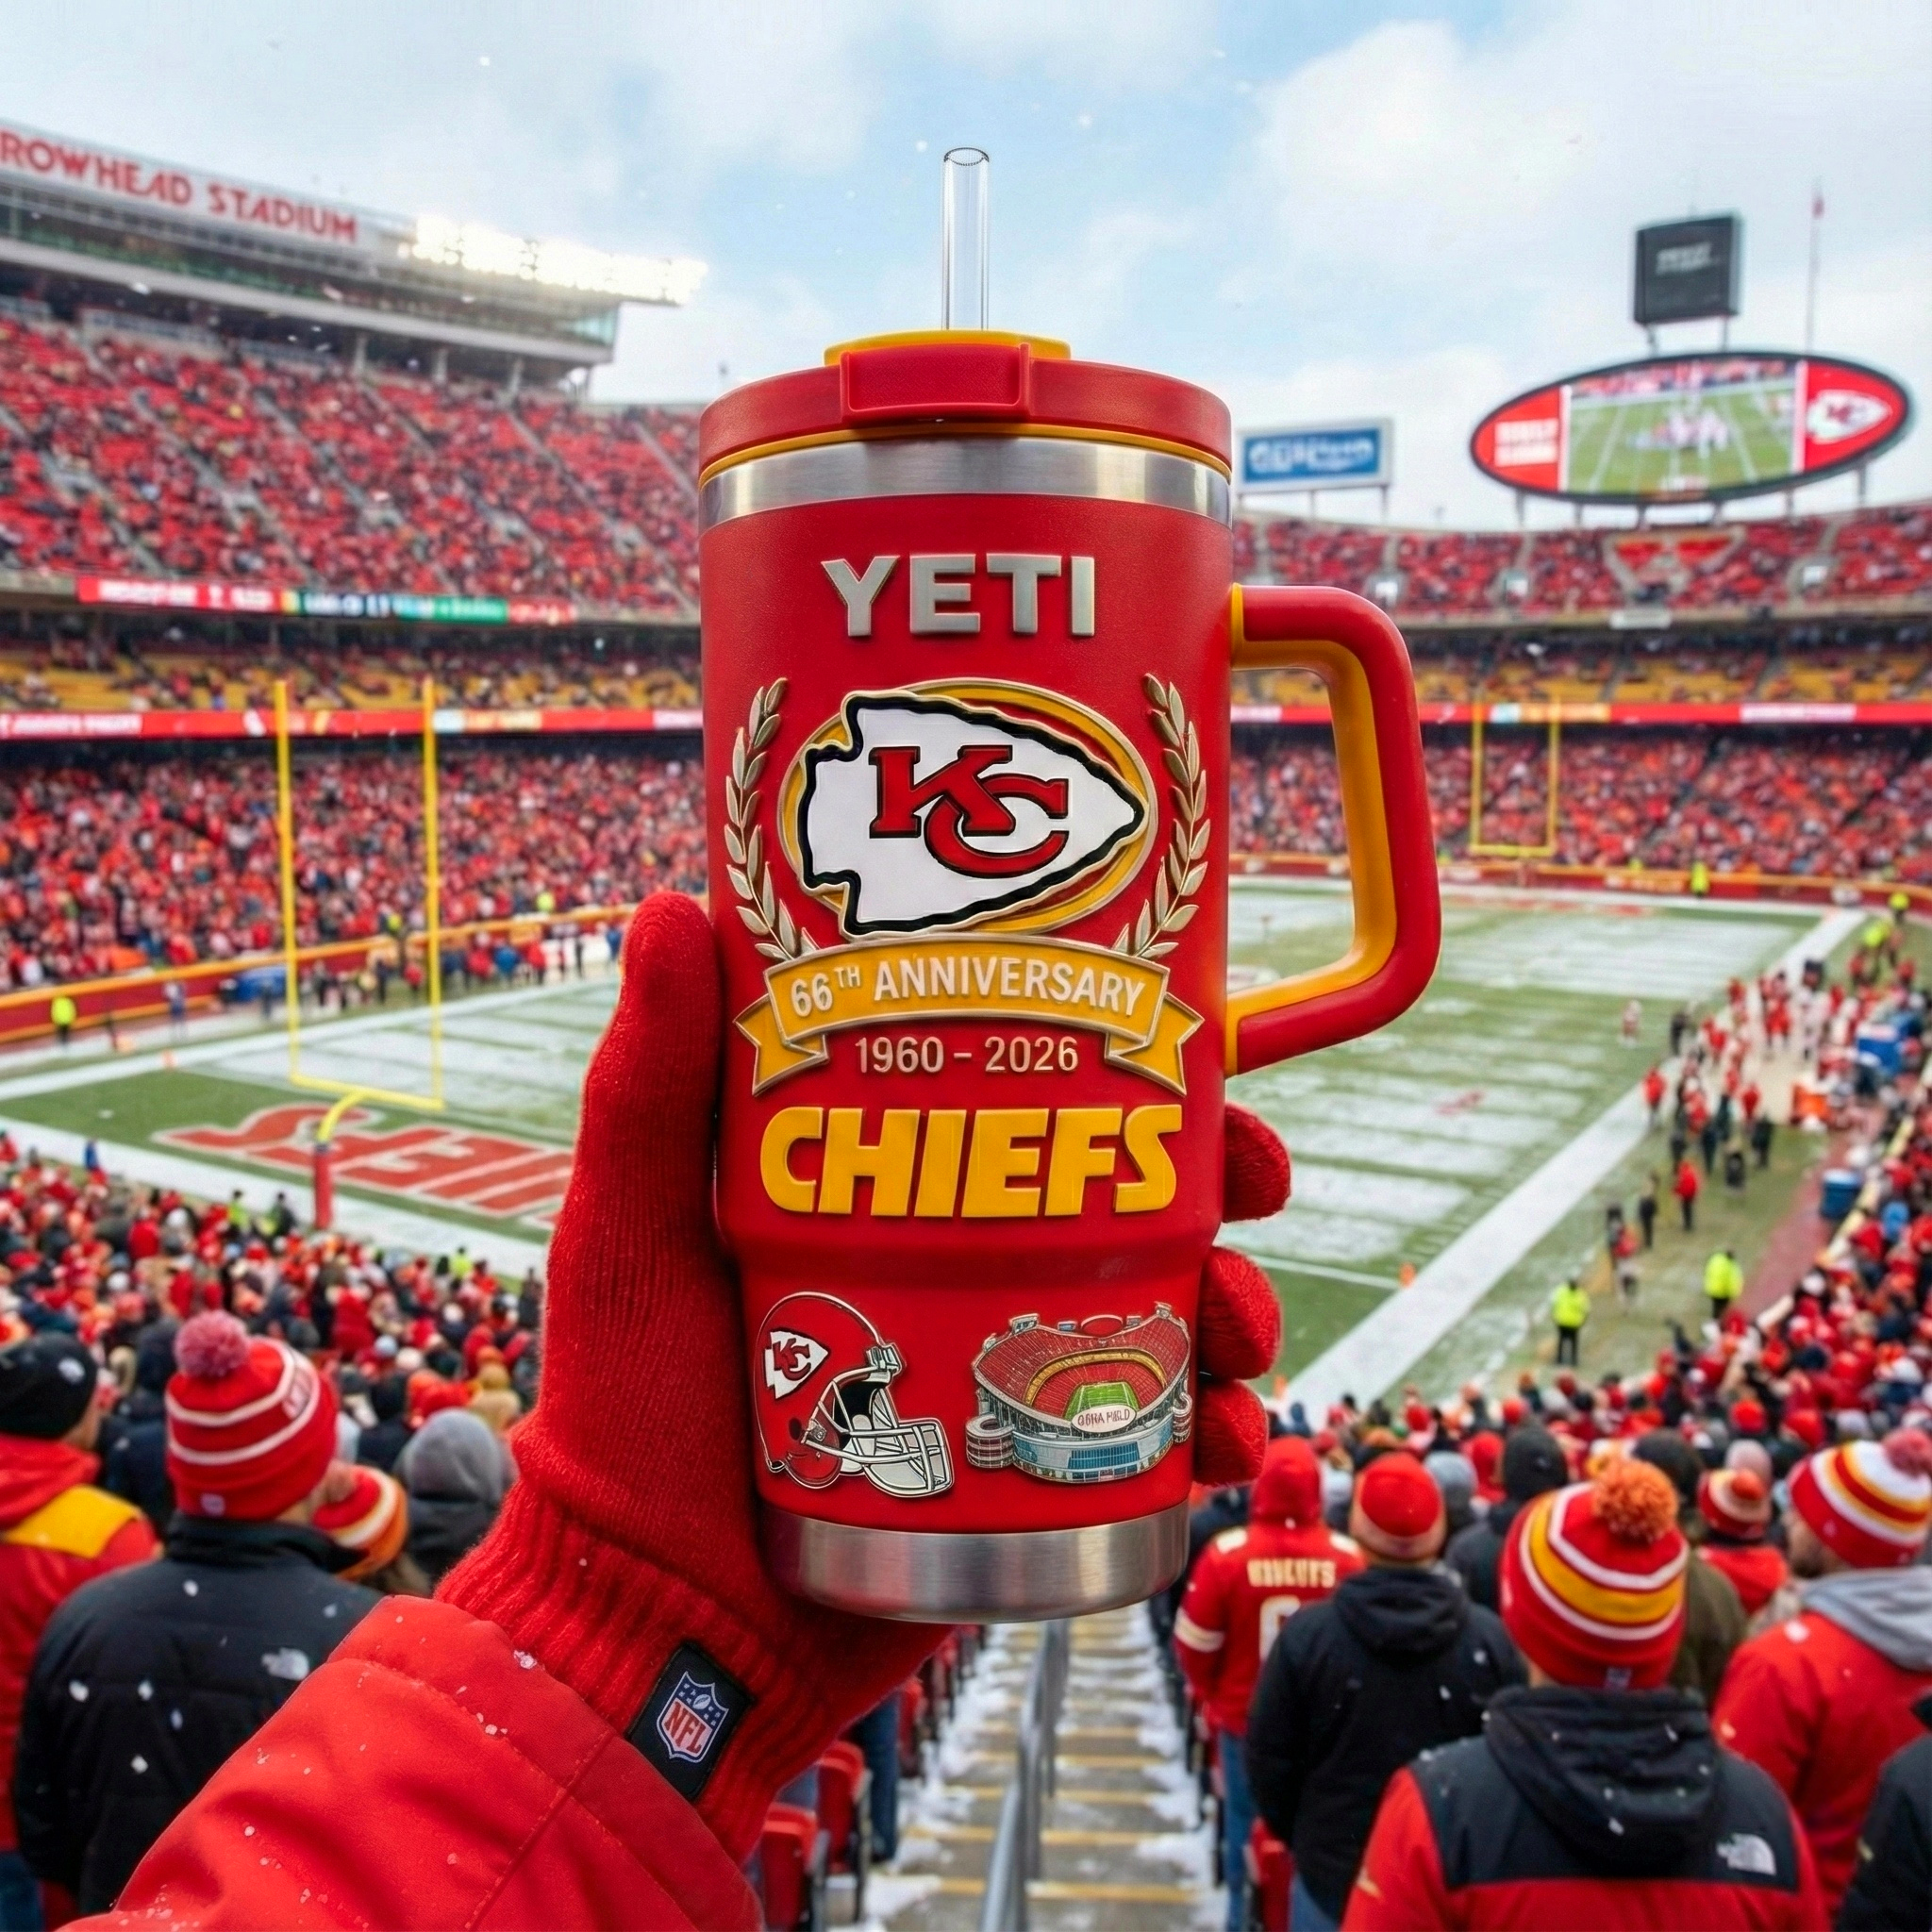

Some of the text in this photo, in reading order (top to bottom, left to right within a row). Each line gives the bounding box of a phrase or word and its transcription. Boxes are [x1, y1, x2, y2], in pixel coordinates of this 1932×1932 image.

[207, 182, 357, 242] STADIUM
[821, 553, 1094, 636] YETI
[869, 745, 1069, 878] KC
[874, 956, 1145, 1017] ANNIVERSARY
[855, 1037, 943, 1074] 1960
[984, 1036, 1079, 1074] 2026
[759, 1105, 1183, 1218] CHIEFS
[773, 1337, 811, 1381] KC
[663, 1700, 708, 1753] NFL
